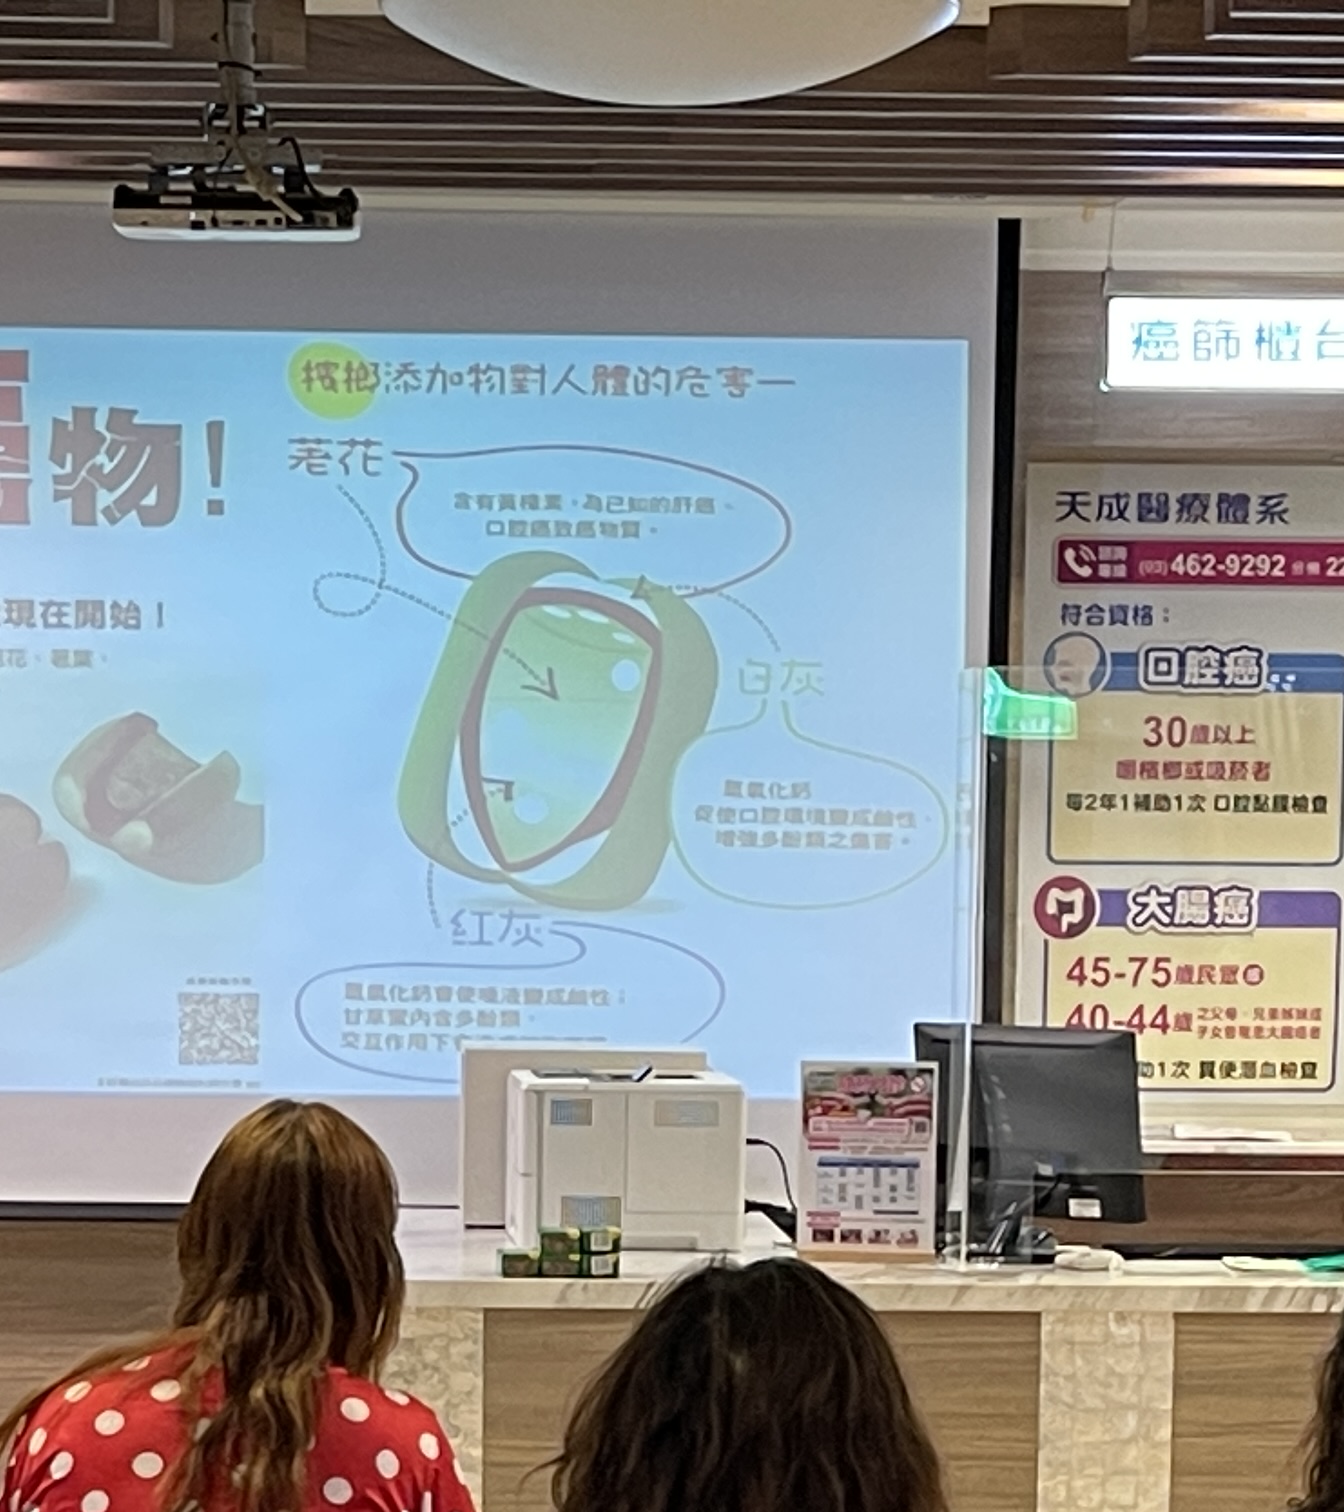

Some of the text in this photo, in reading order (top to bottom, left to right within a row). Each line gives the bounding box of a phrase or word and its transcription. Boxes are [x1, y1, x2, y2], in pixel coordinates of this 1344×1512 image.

[287, 437, 384, 477] 荖花
[1055, 490, 1291, 526] 天成醫療體系
[738, 658, 825, 697] 白灰
[1144, 645, 1266, 688] 口腔癌
[1142, 716, 1256, 748] 30歲以上
[1131, 886, 1254, 927] 大腸癌
